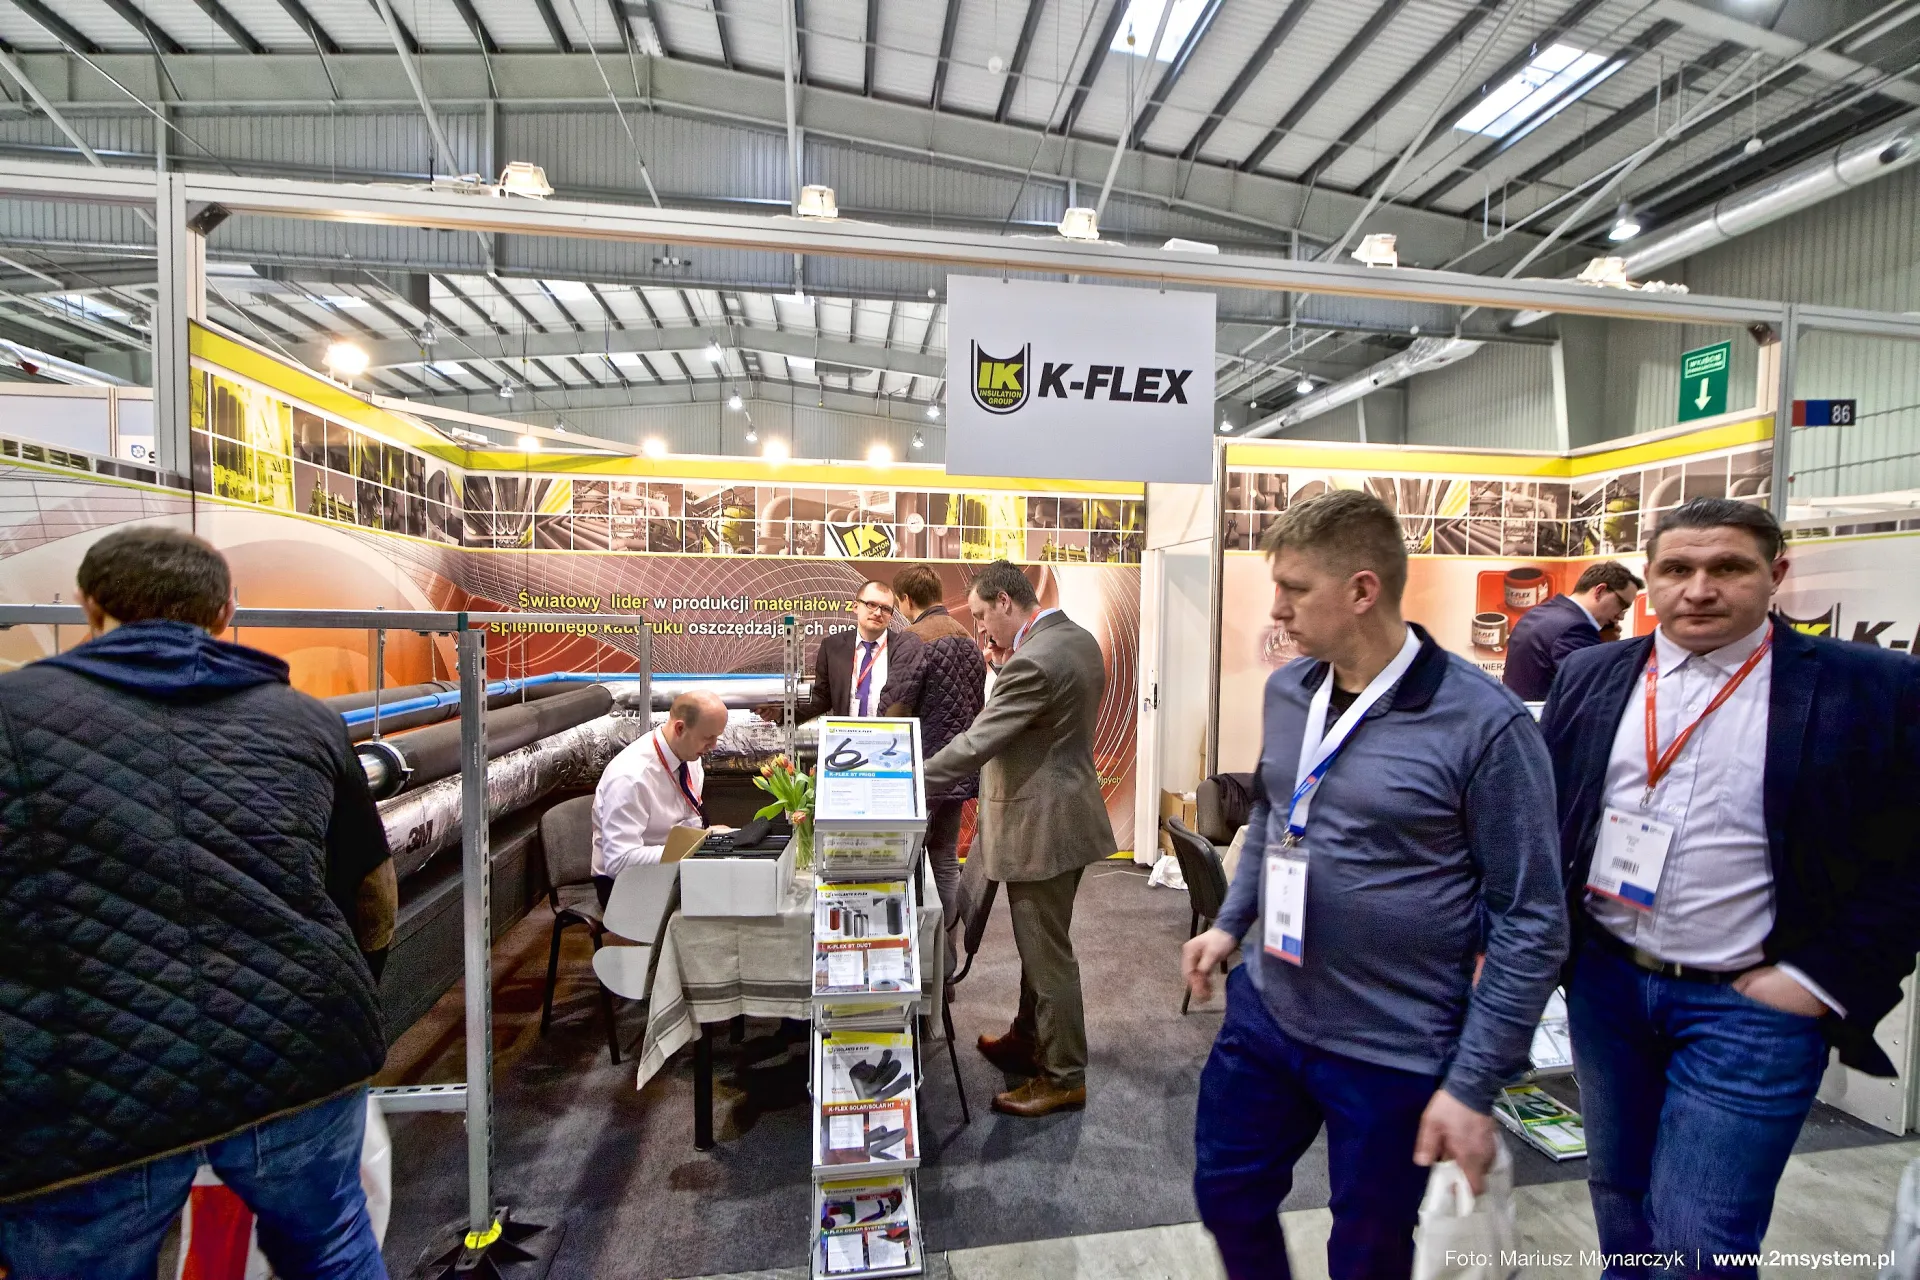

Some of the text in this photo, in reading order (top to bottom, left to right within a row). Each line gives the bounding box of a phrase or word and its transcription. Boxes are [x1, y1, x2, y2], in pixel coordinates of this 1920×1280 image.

[1037, 362, 1194, 405] K-FLEX
[979, 389, 1022, 399] INSULATION
[988, 397, 1014, 405] GROUP
[1831, 404, 1851, 424] 86
[518, 588, 601, 612] Światowy
[611, 593, 649, 609] lider
[653, 598, 667, 609] w
[672, 595, 750, 613] produkcji
[753, 596, 842, 612] materiałów
